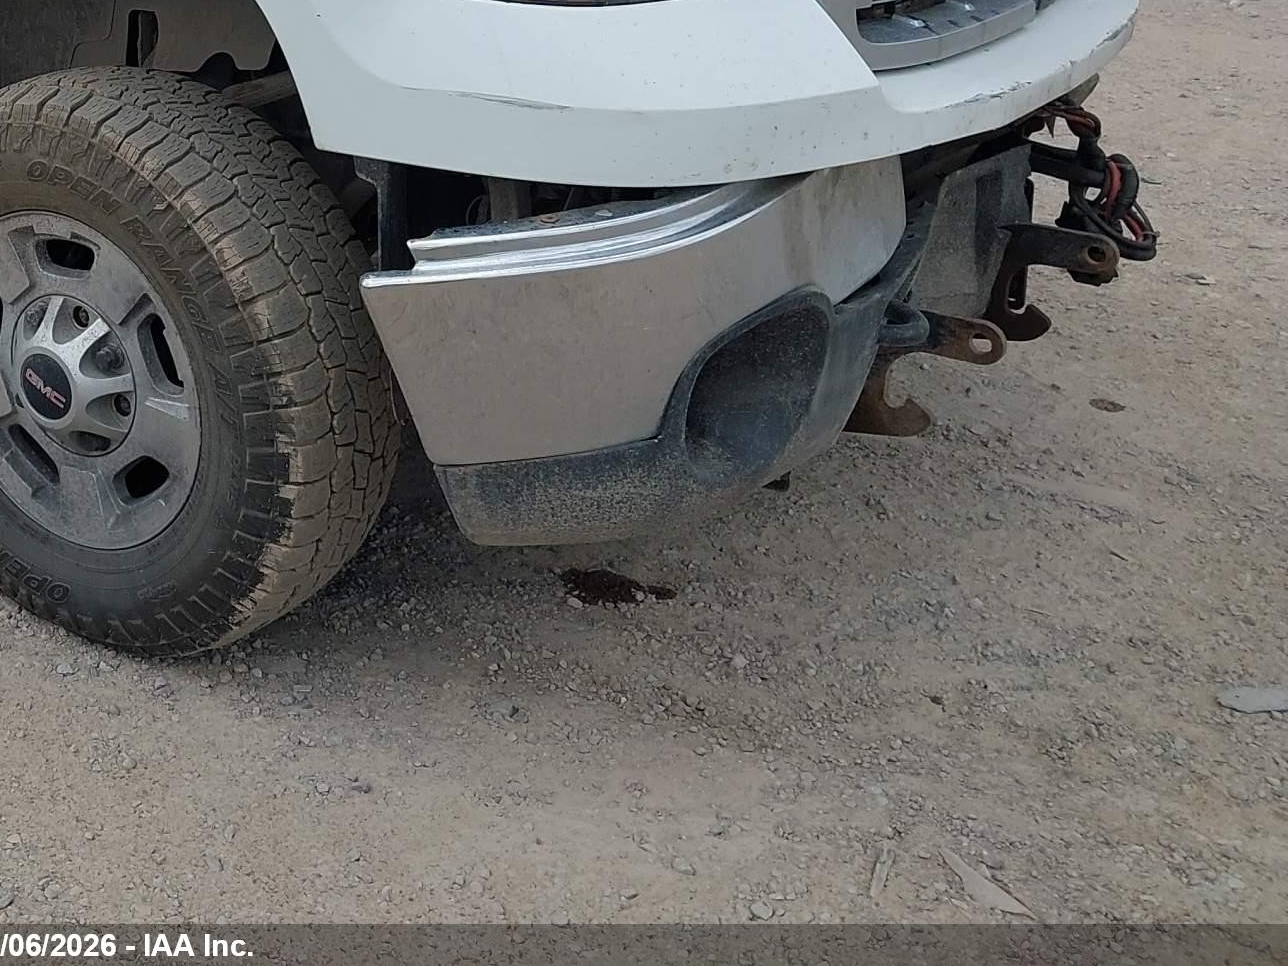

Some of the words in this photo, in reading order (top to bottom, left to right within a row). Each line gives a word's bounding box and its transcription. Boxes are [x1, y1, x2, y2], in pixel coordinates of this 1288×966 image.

[26, 160, 121, 215] OPEN
[119, 214, 224, 354] RANGE
[25, 368, 66, 409] GMC
